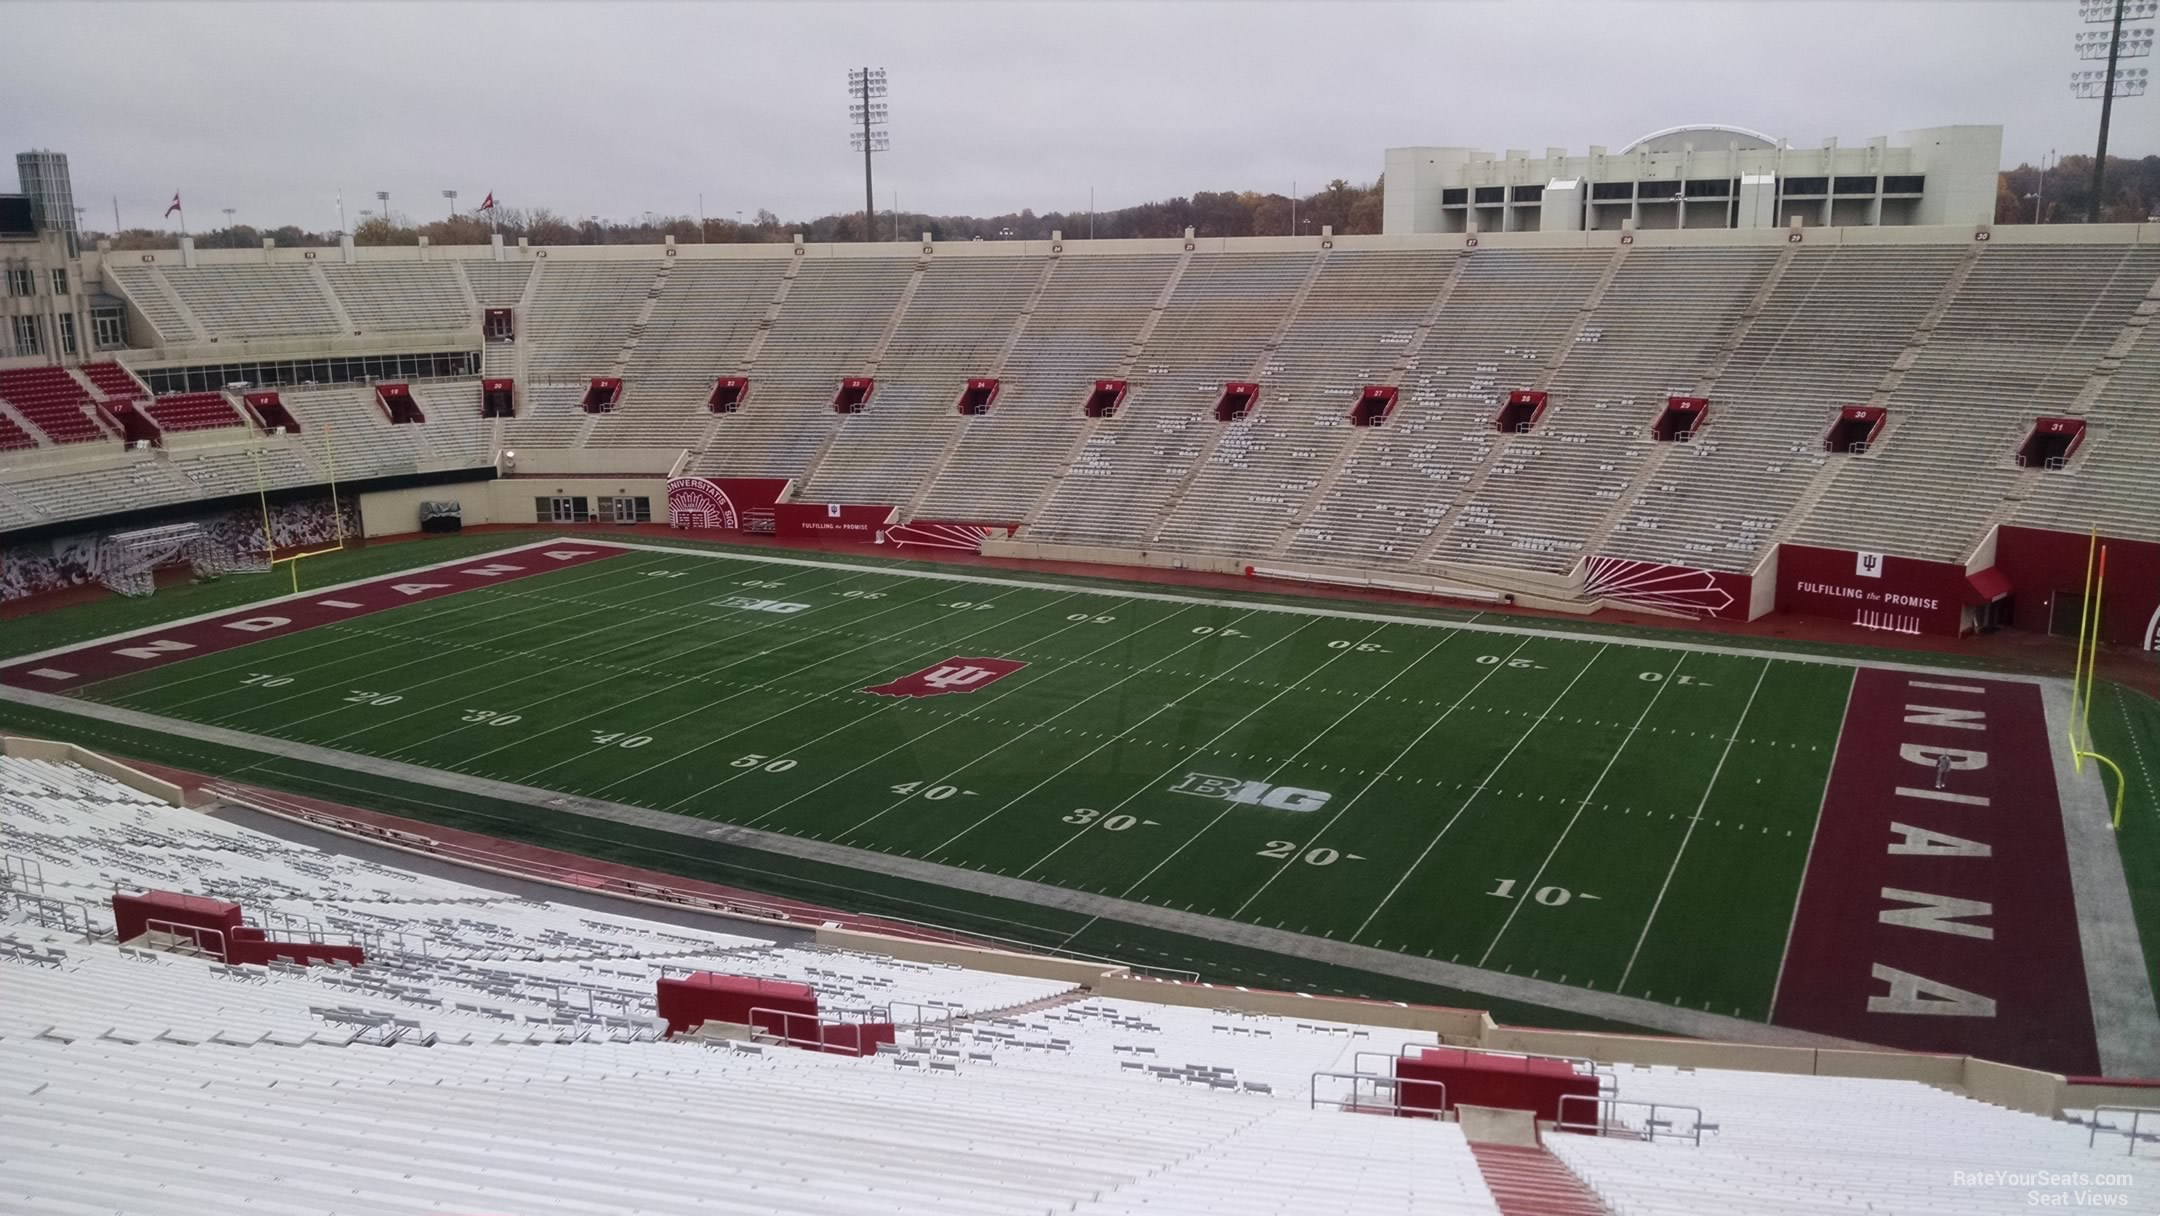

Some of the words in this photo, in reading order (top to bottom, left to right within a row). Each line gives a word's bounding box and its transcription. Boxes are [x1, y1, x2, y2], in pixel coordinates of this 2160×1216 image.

[1797, 582, 1863, 599] FULFILLING
[1866, 592, 1881, 600] the
[1884, 593, 1939, 610] PROMISE
[28, 548, 597, 681] INDIANA
[1066, 613, 1116, 624] 50
[1192, 626, 1242, 637] 40
[1327, 640, 1382, 652] 30
[1475, 655, 1535, 669] 20
[240, 674, 295, 688] 10
[1638, 671, 1697, 685] 10
[344, 691, 403, 706] 20
[461, 710, 522, 726] 30
[591, 732, 653, 748] 40
[730, 754, 798, 773] 50
[891, 780, 958, 801] 40
[1062, 808, 1138, 831] 30
[1256, 840, 1341, 866] 20
[1867, 680, 1997, 1017] INDIANA
[1485, 878, 1572, 906] 10
